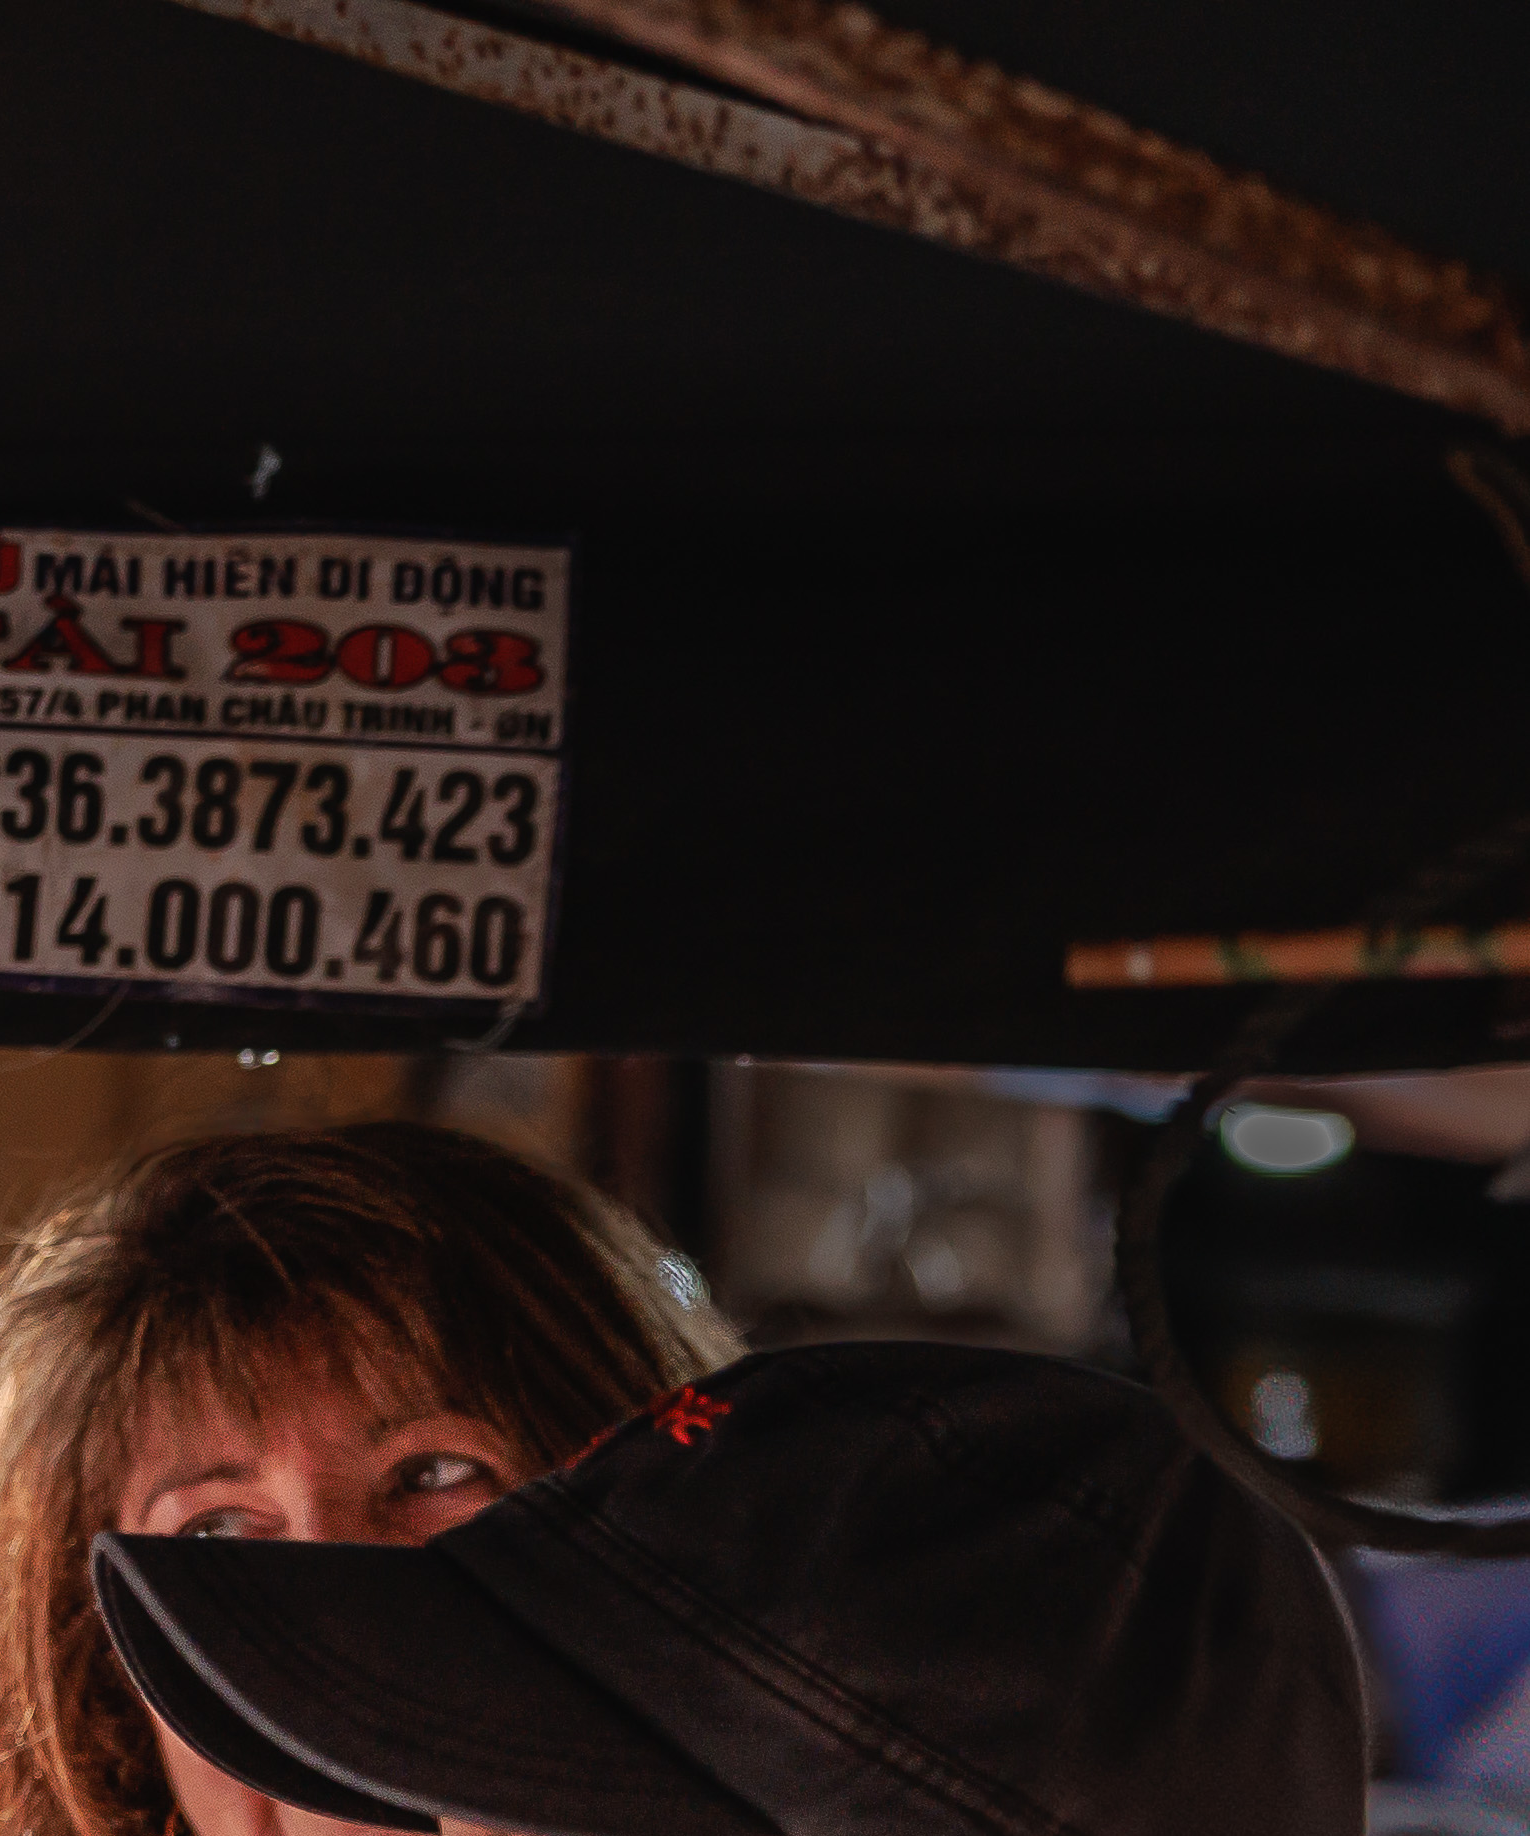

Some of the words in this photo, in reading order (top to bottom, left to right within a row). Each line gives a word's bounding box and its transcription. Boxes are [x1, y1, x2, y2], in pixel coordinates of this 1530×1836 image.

[318, 556, 374, 602] DI
[220, 617, 546, 697] 203
[96, 690, 207, 724] PHAN
[342, 702, 458, 737] TRINH
